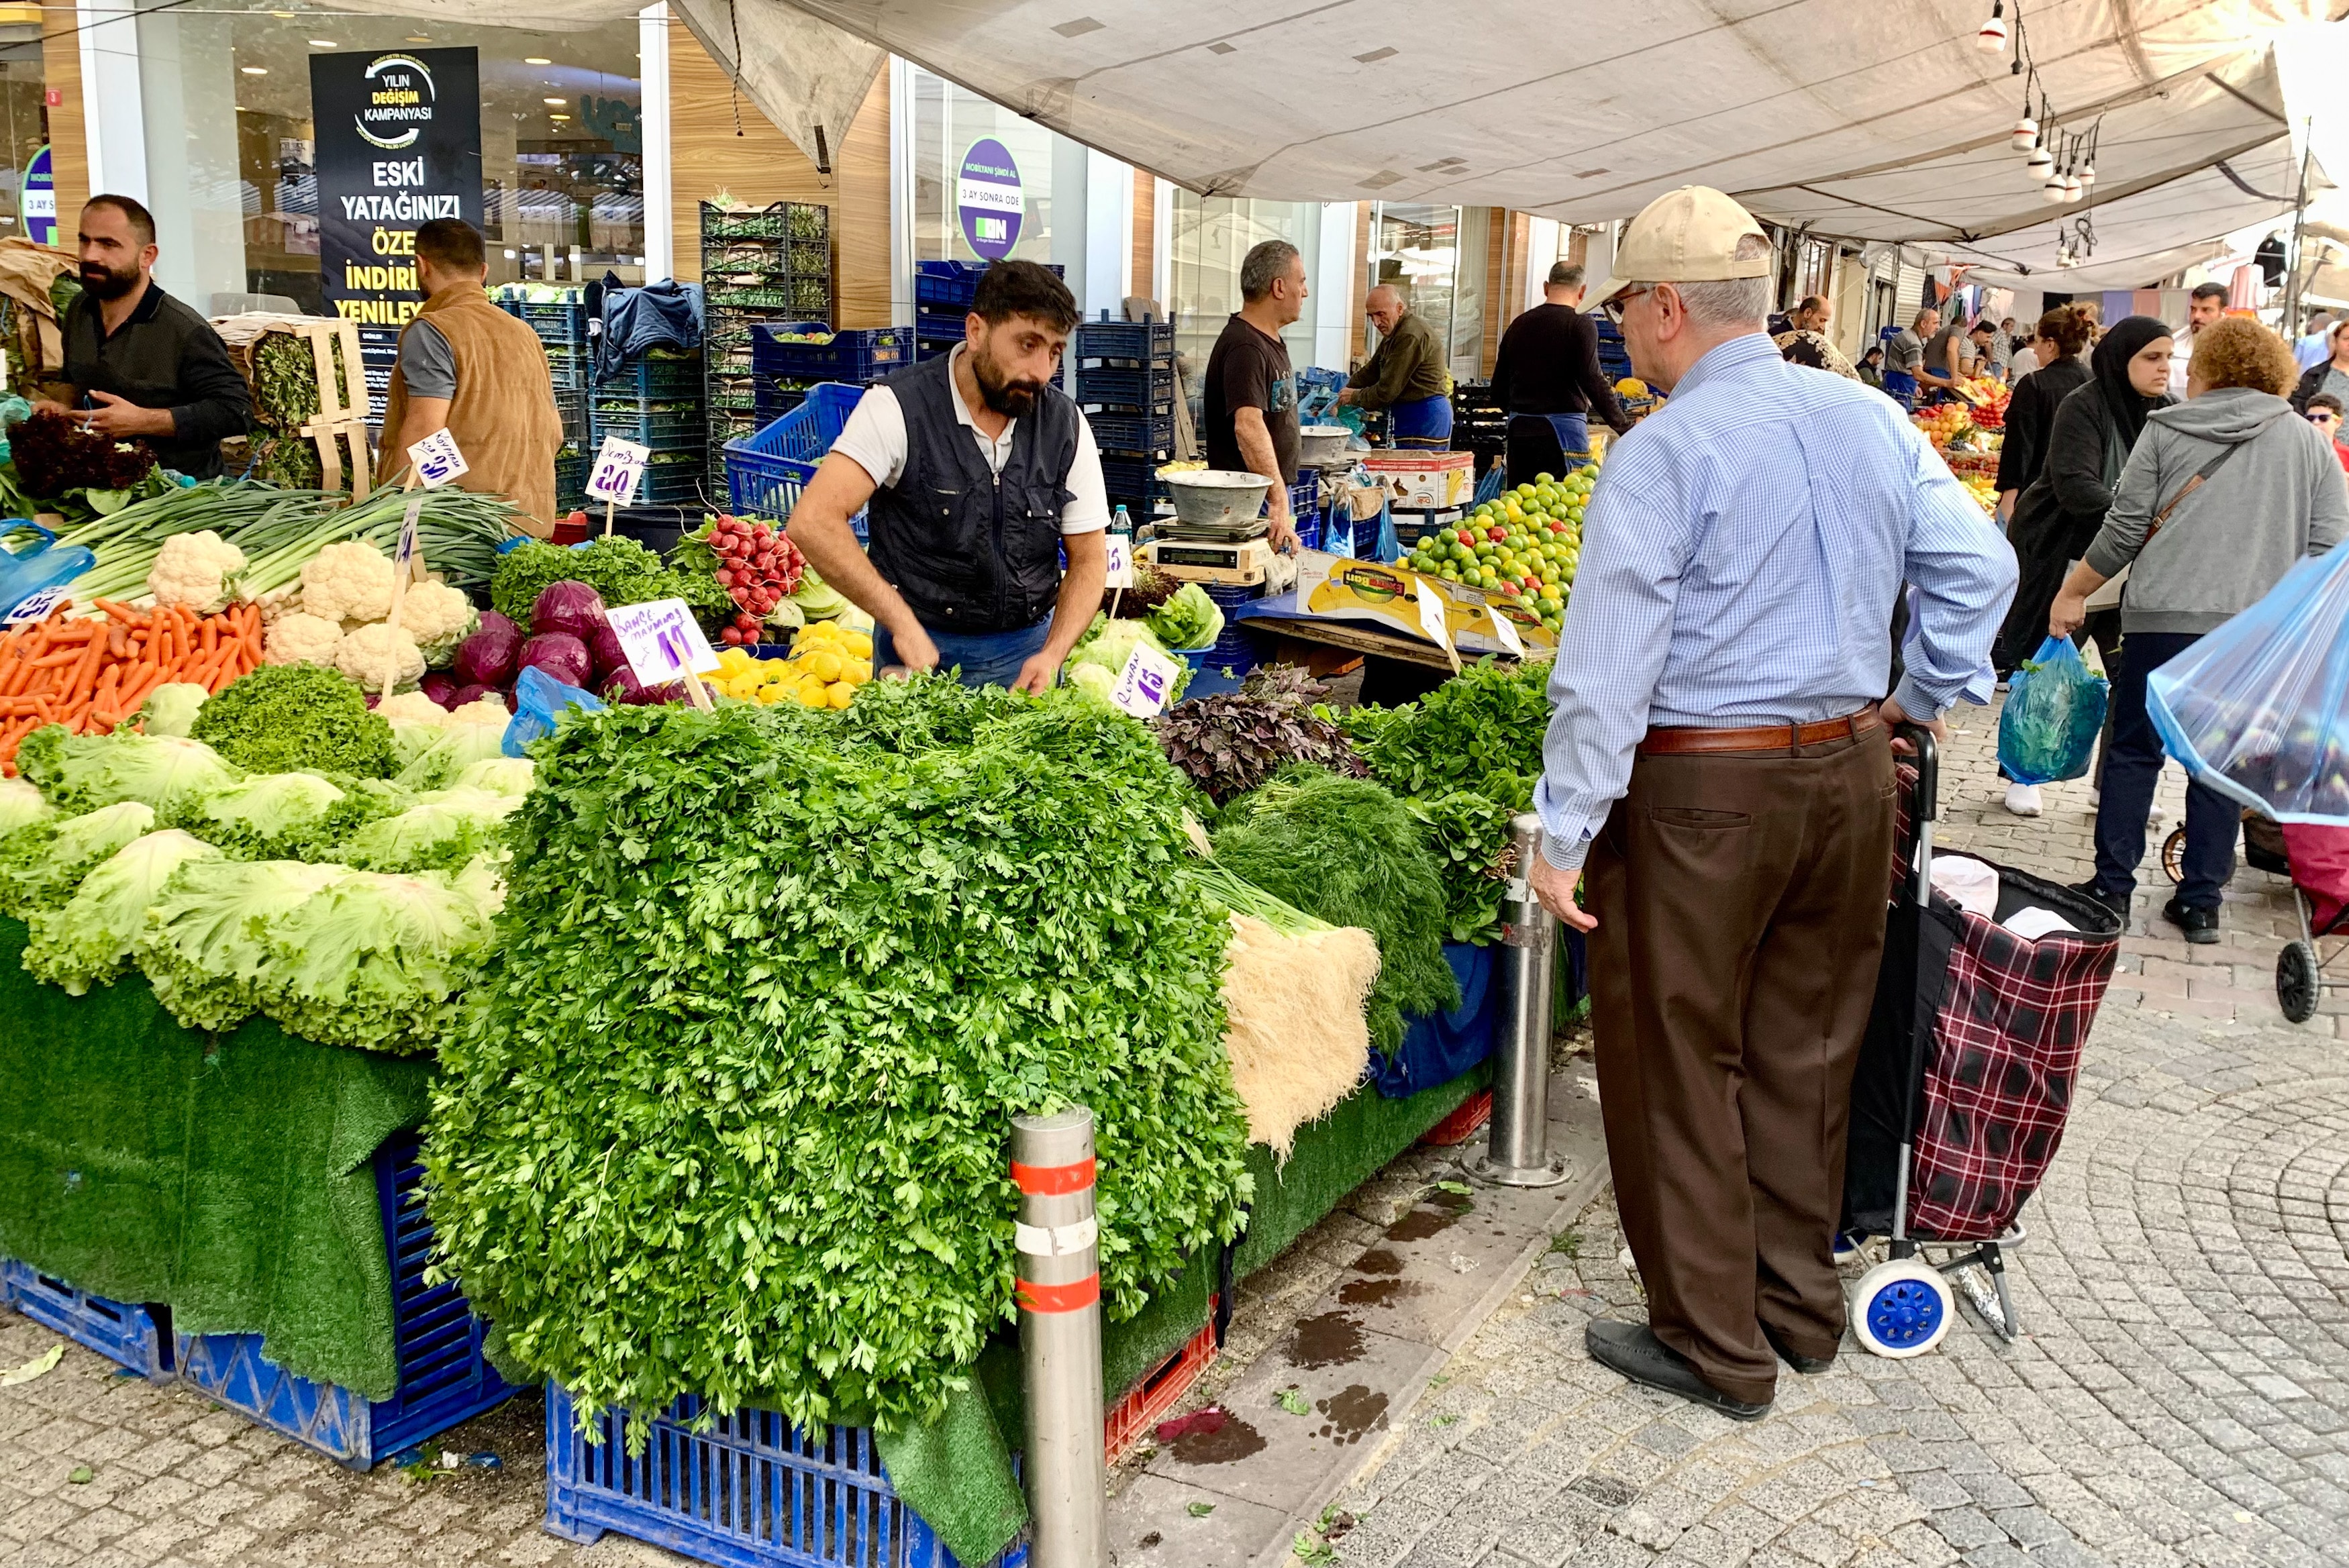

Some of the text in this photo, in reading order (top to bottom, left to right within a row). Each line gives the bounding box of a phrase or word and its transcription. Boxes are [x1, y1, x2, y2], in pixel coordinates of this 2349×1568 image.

[382, 74, 410, 87] YILIN
[372, 88, 419, 107] DEĞİŞİM
[364, 107, 432, 121] KAMPANYASI
[372, 156, 424, 187] ESKİ
[966, 162, 1016, 178] MOBİLYANI ŞİMDİ AL
[29, 200, 34, 210] 3
[36, 200, 47, 210] AY
[340, 191, 460, 220] YATAĞINIZI
[962, 189, 966, 199] 3
[969, 190, 977, 199] AY
[979, 192, 1003, 203] SONRA
[372, 226, 416, 255] ÖZE
[346, 259, 420, 291] İNDİRİ
[334, 293, 426, 325] YENİLEY
[595, 464, 628, 494] 20
[656, 625, 694, 671] 10
[1138, 668, 1164, 705] 15
